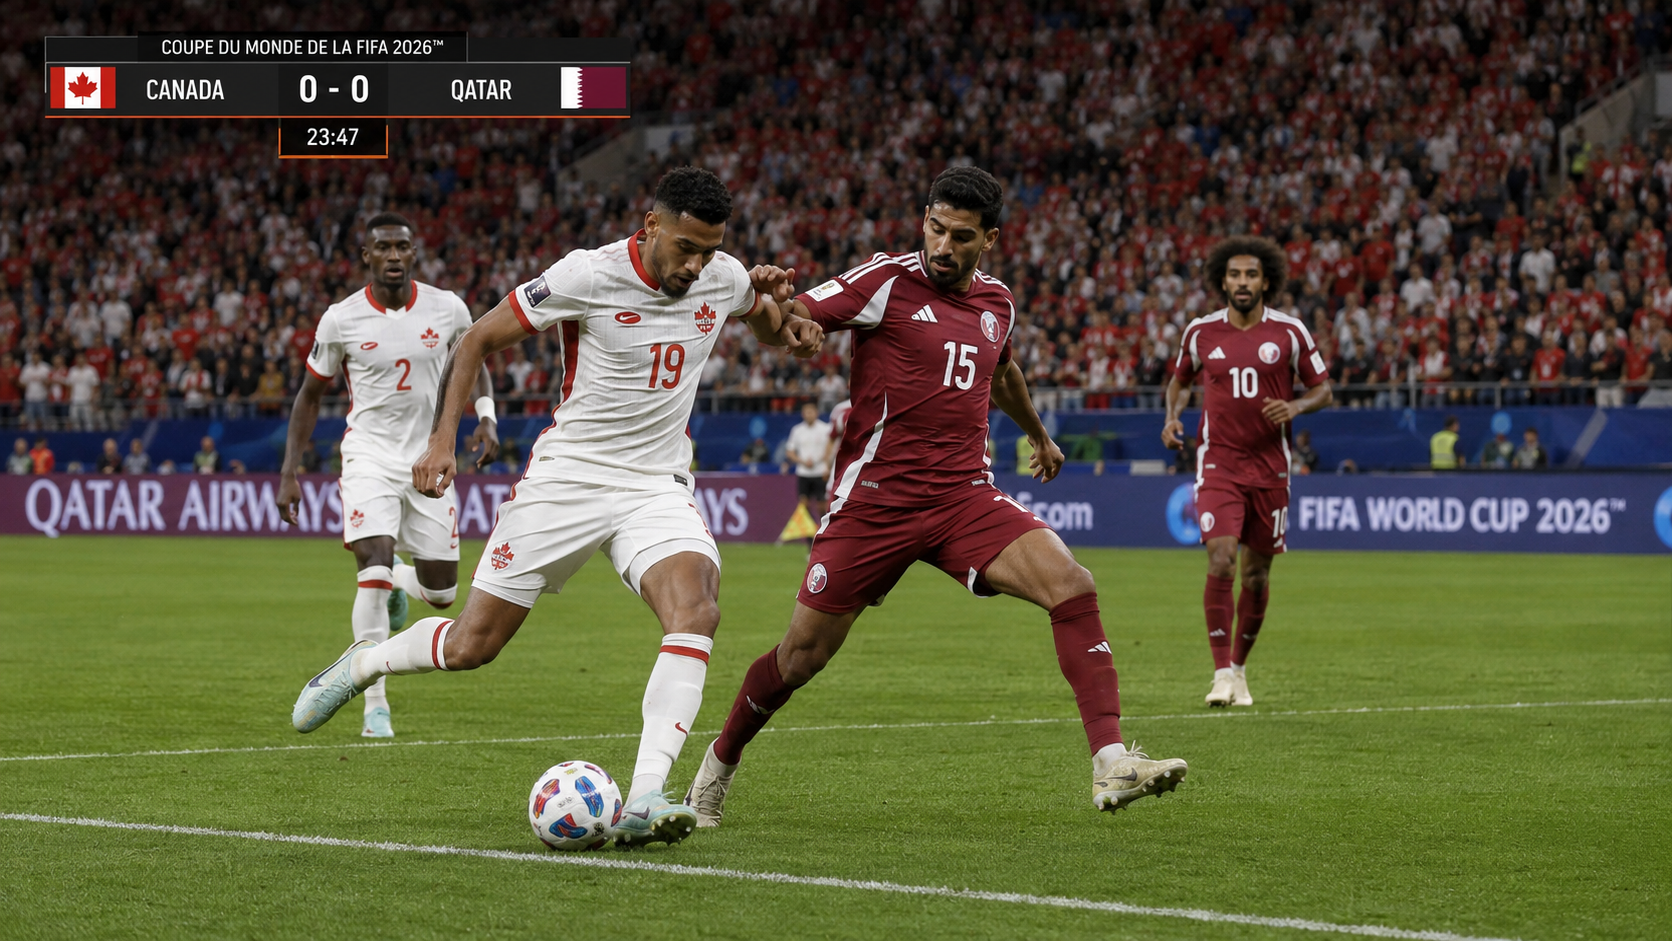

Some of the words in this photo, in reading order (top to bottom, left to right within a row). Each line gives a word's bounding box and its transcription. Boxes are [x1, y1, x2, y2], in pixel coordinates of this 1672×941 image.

[395, 358, 412, 391] 2
[649, 343, 685, 390] 19
[942, 341, 979, 391] 15
[1228, 366, 1259, 399] 10
[25, 479, 165, 538] QATAR
[1271, 506, 1288, 538] 10
[1299, 495, 1361, 531] FIFA
[1365, 496, 1466, 532] WORLD
[1469, 496, 1530, 533] CUP
